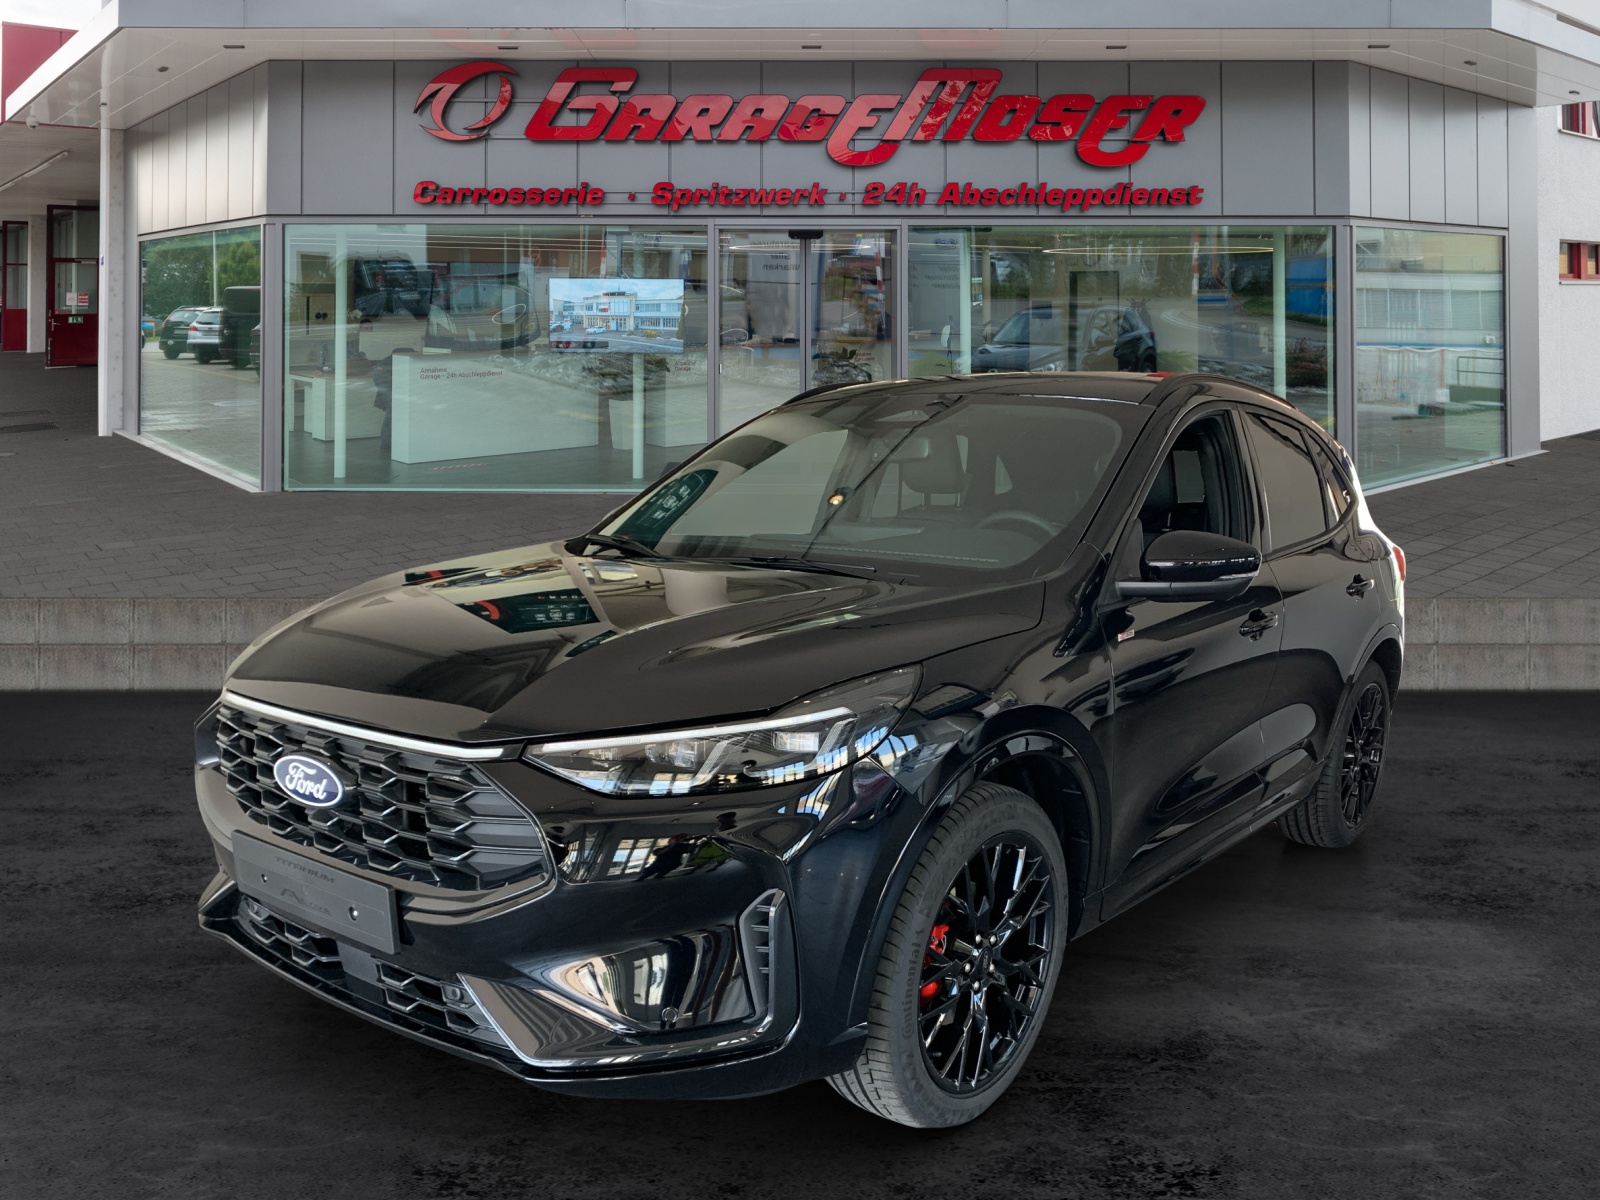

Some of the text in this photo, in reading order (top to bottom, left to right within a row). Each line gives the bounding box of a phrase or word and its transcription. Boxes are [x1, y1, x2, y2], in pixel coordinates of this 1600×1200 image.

[413, 180, 1205, 212] Carrosserie Spritzwerk 24h Abschleppdienst
[285, 762, 328, 800] Ford
[902, 942, 922, 1039] Continental
